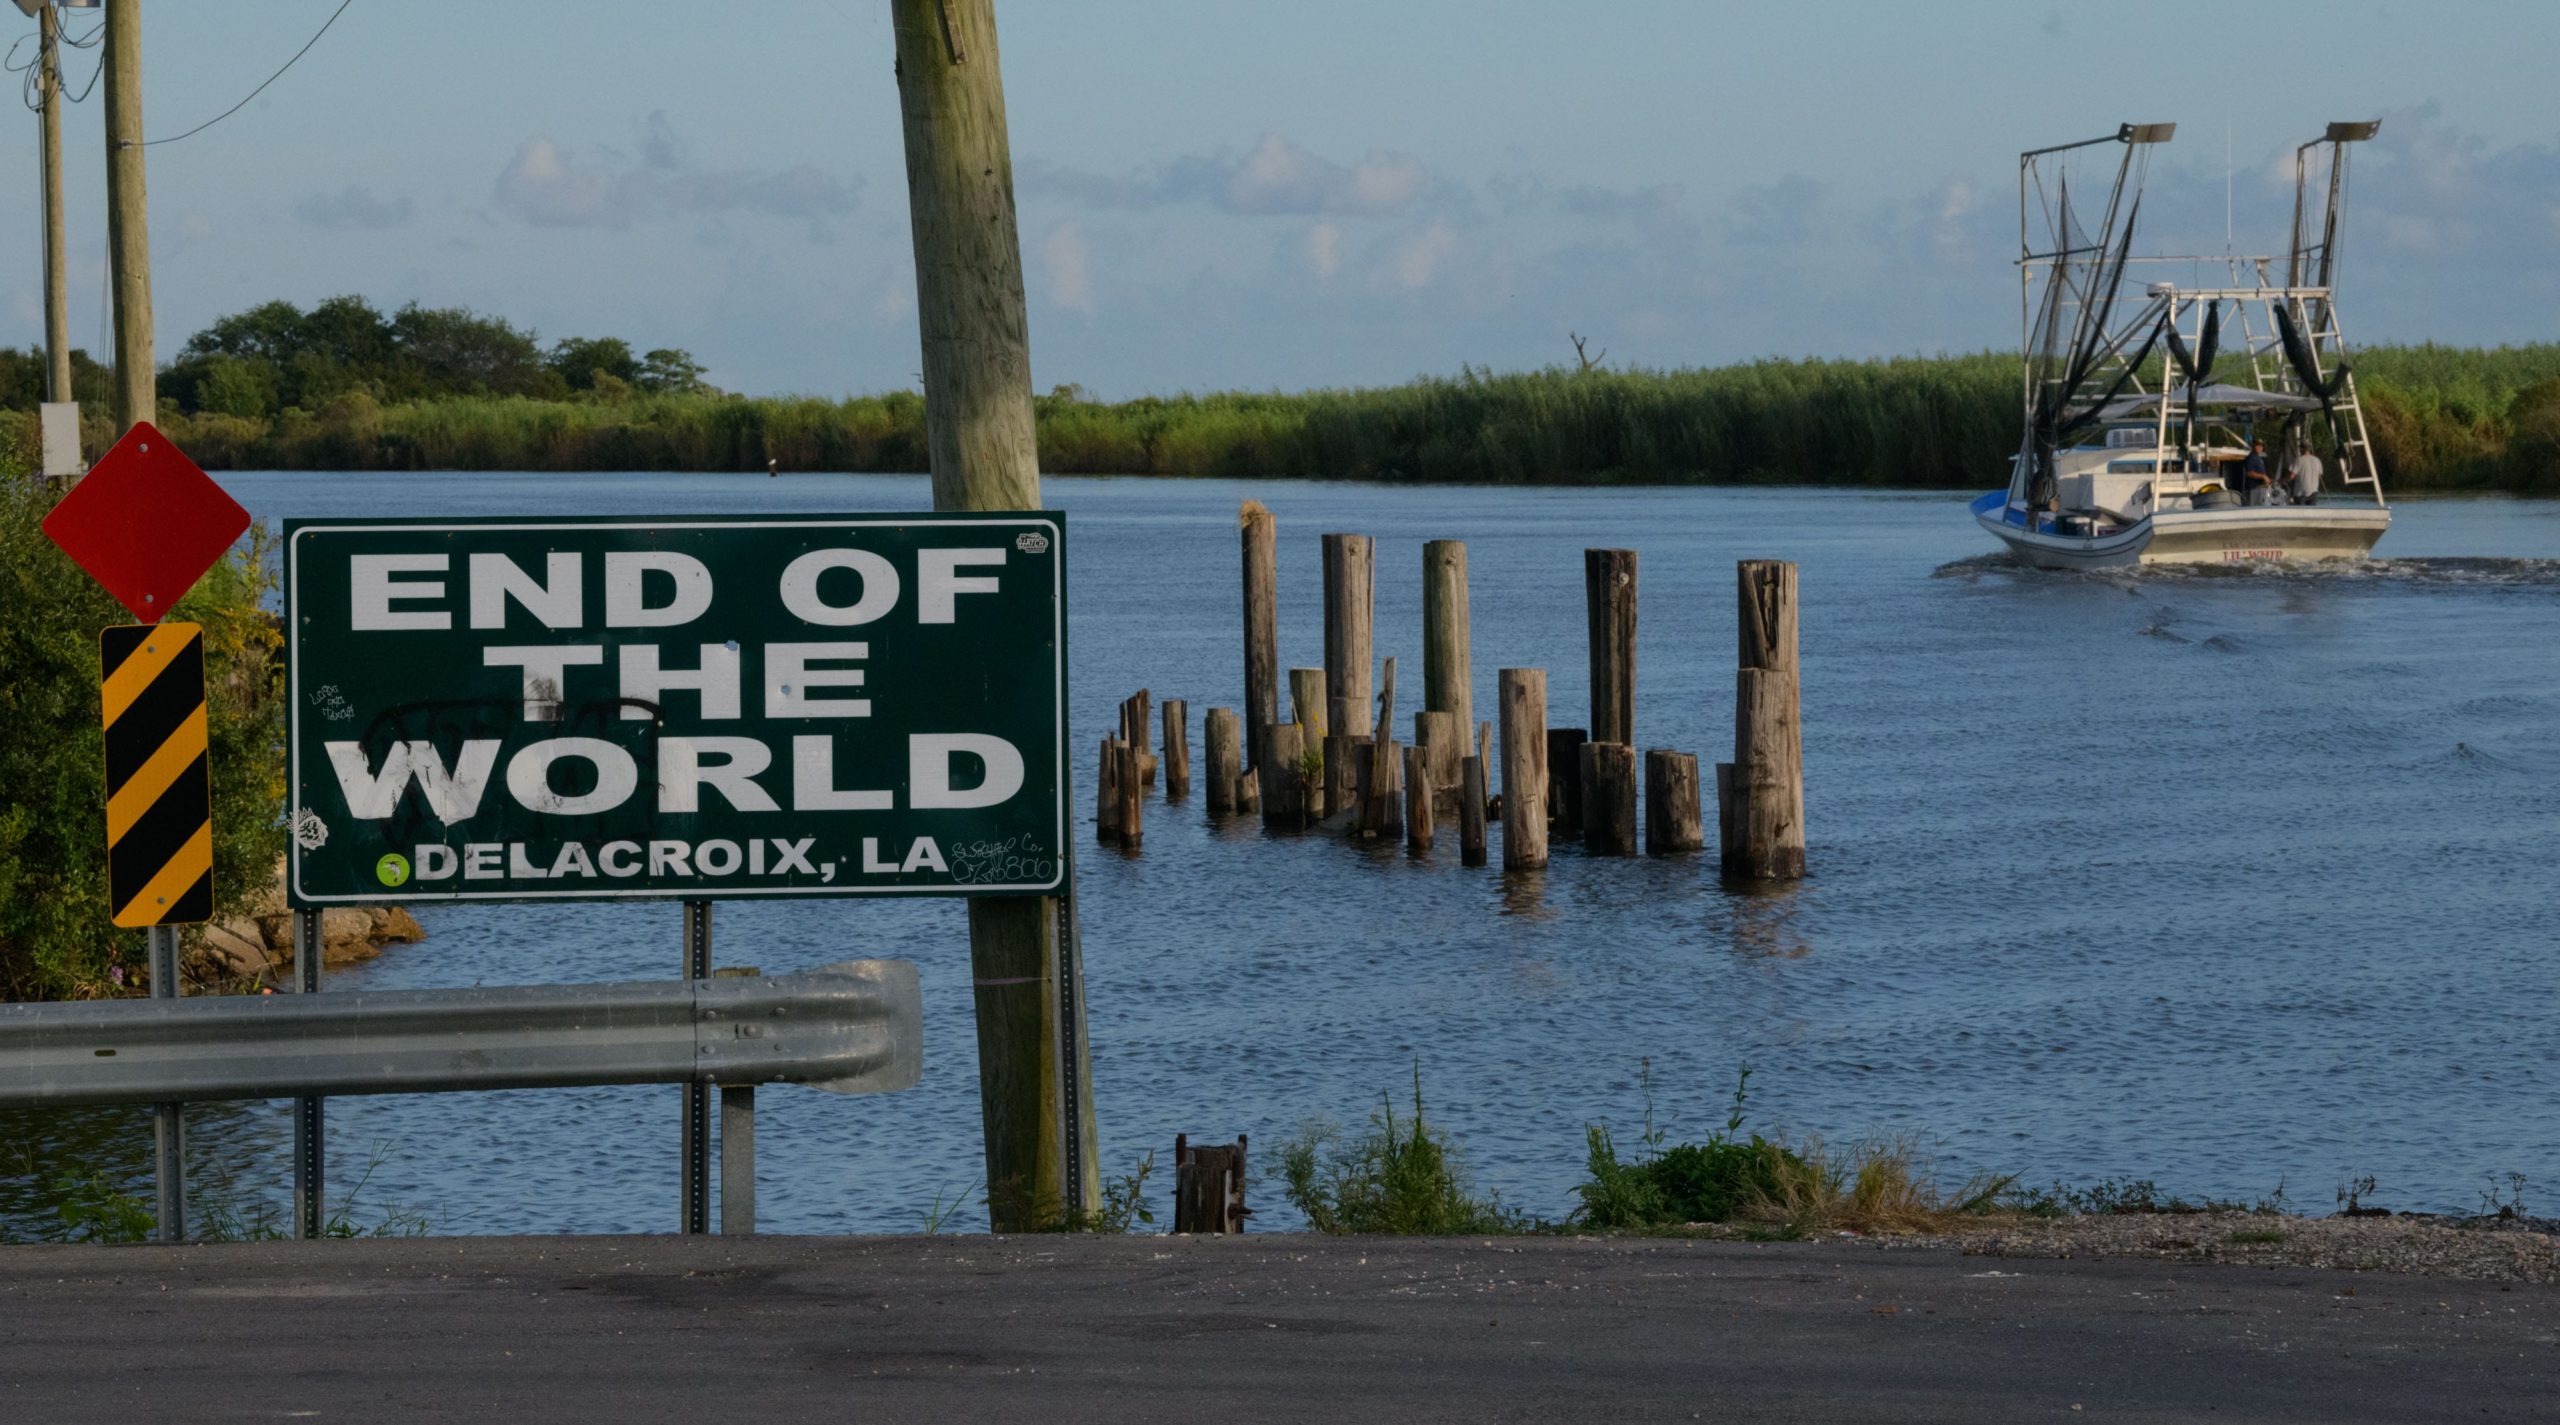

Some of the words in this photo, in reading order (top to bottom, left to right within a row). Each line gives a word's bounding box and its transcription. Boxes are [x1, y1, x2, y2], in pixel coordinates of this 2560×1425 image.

[351, 552, 713, 630] END
[780, 548, 1007, 626] OF
[484, 642, 872, 721] THE
[324, 733, 1025, 825] WORLD
[416, 838, 835, 883] DELACROIX,
[863, 836, 949, 873] LA
